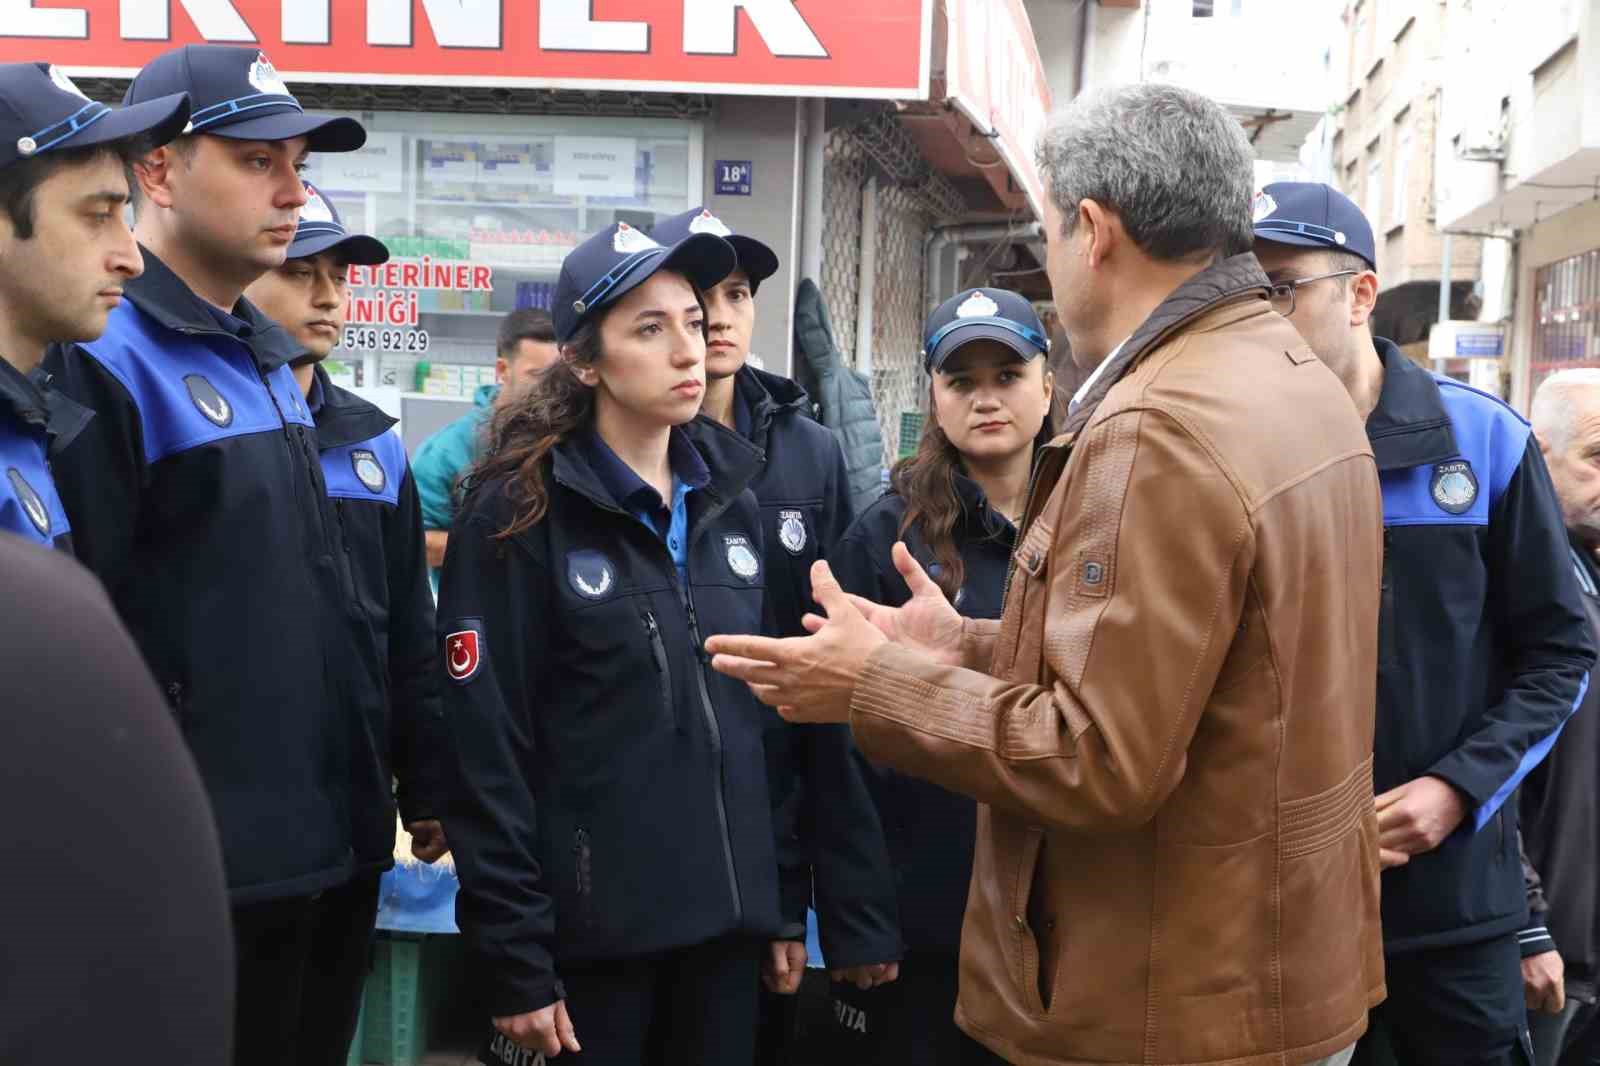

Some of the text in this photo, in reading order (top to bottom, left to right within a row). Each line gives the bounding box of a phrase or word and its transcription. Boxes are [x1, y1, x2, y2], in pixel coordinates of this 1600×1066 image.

[346, 330, 376, 349] 548
[383, 331, 402, 350] 92
[408, 332, 428, 351] 29
